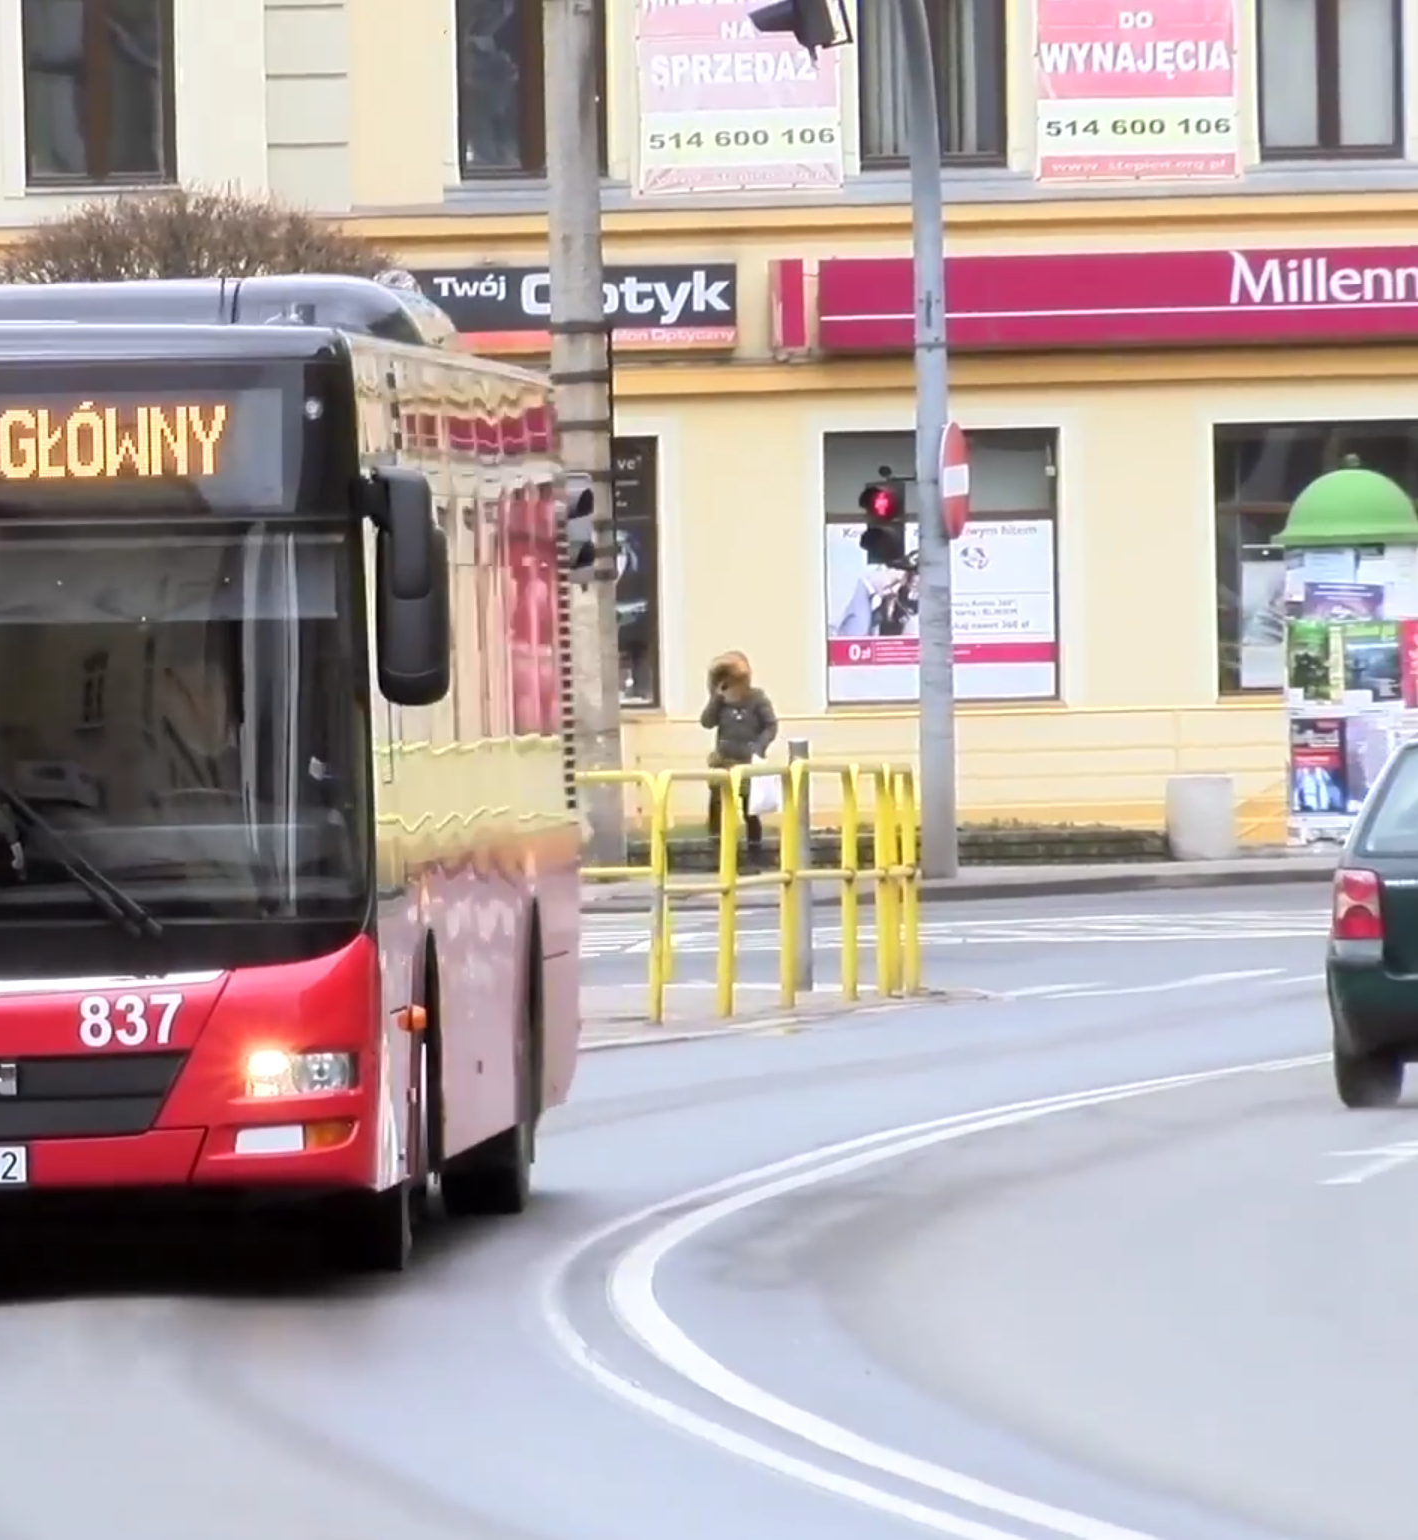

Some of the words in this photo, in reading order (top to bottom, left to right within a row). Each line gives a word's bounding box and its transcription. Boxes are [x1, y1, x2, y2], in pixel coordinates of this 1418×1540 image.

[720, 21, 756, 39] NA
[1118, 11, 1153, 29] DO
[1040, 40, 1231, 80] WYNAJĘCIA
[1046, 120, 1100, 137] 514
[1111, 119, 1165, 135] 600
[1177, 118, 1231, 134] 106
[649, 132, 704, 150] 514
[714, 130, 769, 147] 600
[781, 128, 835, 145] 106
[433, 273, 507, 301] Twój
[520, 270, 731, 325] Otyk
[79, 993, 183, 1048] 837
